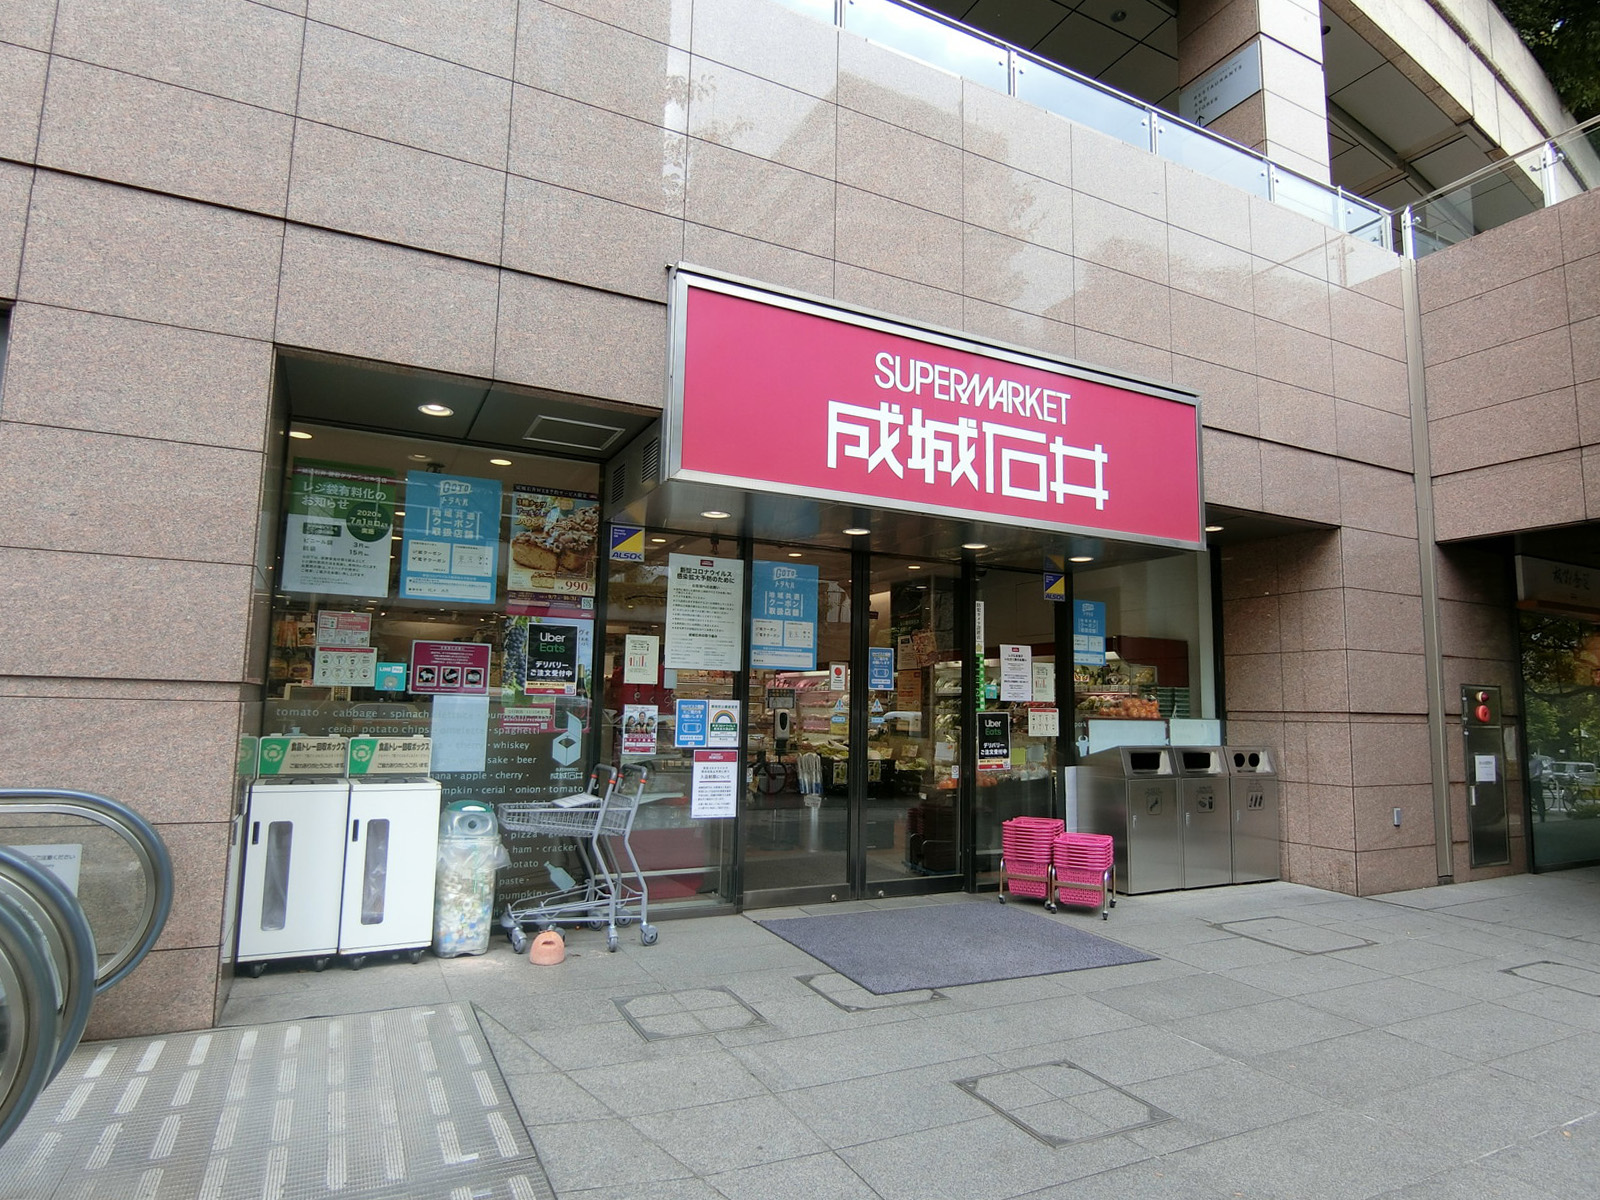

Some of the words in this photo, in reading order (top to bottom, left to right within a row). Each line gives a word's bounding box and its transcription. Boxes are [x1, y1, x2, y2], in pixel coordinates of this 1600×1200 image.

[1193, 64, 1242, 101] RESTAURANTS
[874, 352, 1071, 426] SUPERMARKET
[827, 399, 1110, 511] 成城石井
[303, 481, 387, 502] レジ袋有料化の
[301, 494, 350, 510] お知らせ
[432, 517, 474, 529] クーポン
[611, 551, 643, 560] ALSOK
[680, 566, 733, 578] 新型コロナウイルス
[768, 599, 800, 608] クーポン
[540, 632, 566, 643] Uber
[540, 643, 566, 653] Eats
[530, 669, 573, 677] ご注文受付中
[276, 708, 320, 718] tomato
[332, 708, 378, 718] cabbage
[390, 709, 430, 719] spinach
[984, 719, 1002, 728] Uber
[328, 725, 356, 734] cerial
[362, 725, 399, 734] potato
[401, 725, 430, 735] chips
[493, 727, 541, 736] spaghetti
[984, 728, 1002, 736] Eats
[493, 741, 530, 751] whiskey
[487, 756, 509, 764] sake
[516, 756, 538, 765] beer
[460, 771, 487, 780] apple
[495, 771, 524, 781] cherry
[481, 785, 506, 794] cerial
[515, 785, 542, 794] onion
[549, 785, 584, 793] tomato
[510, 831, 538, 840] pizza
[512, 845, 532, 854] ham
[542, 843, 578, 853] cracker
[500, 877, 525, 887] paste
[499, 890, 542, 901] pumpkin
